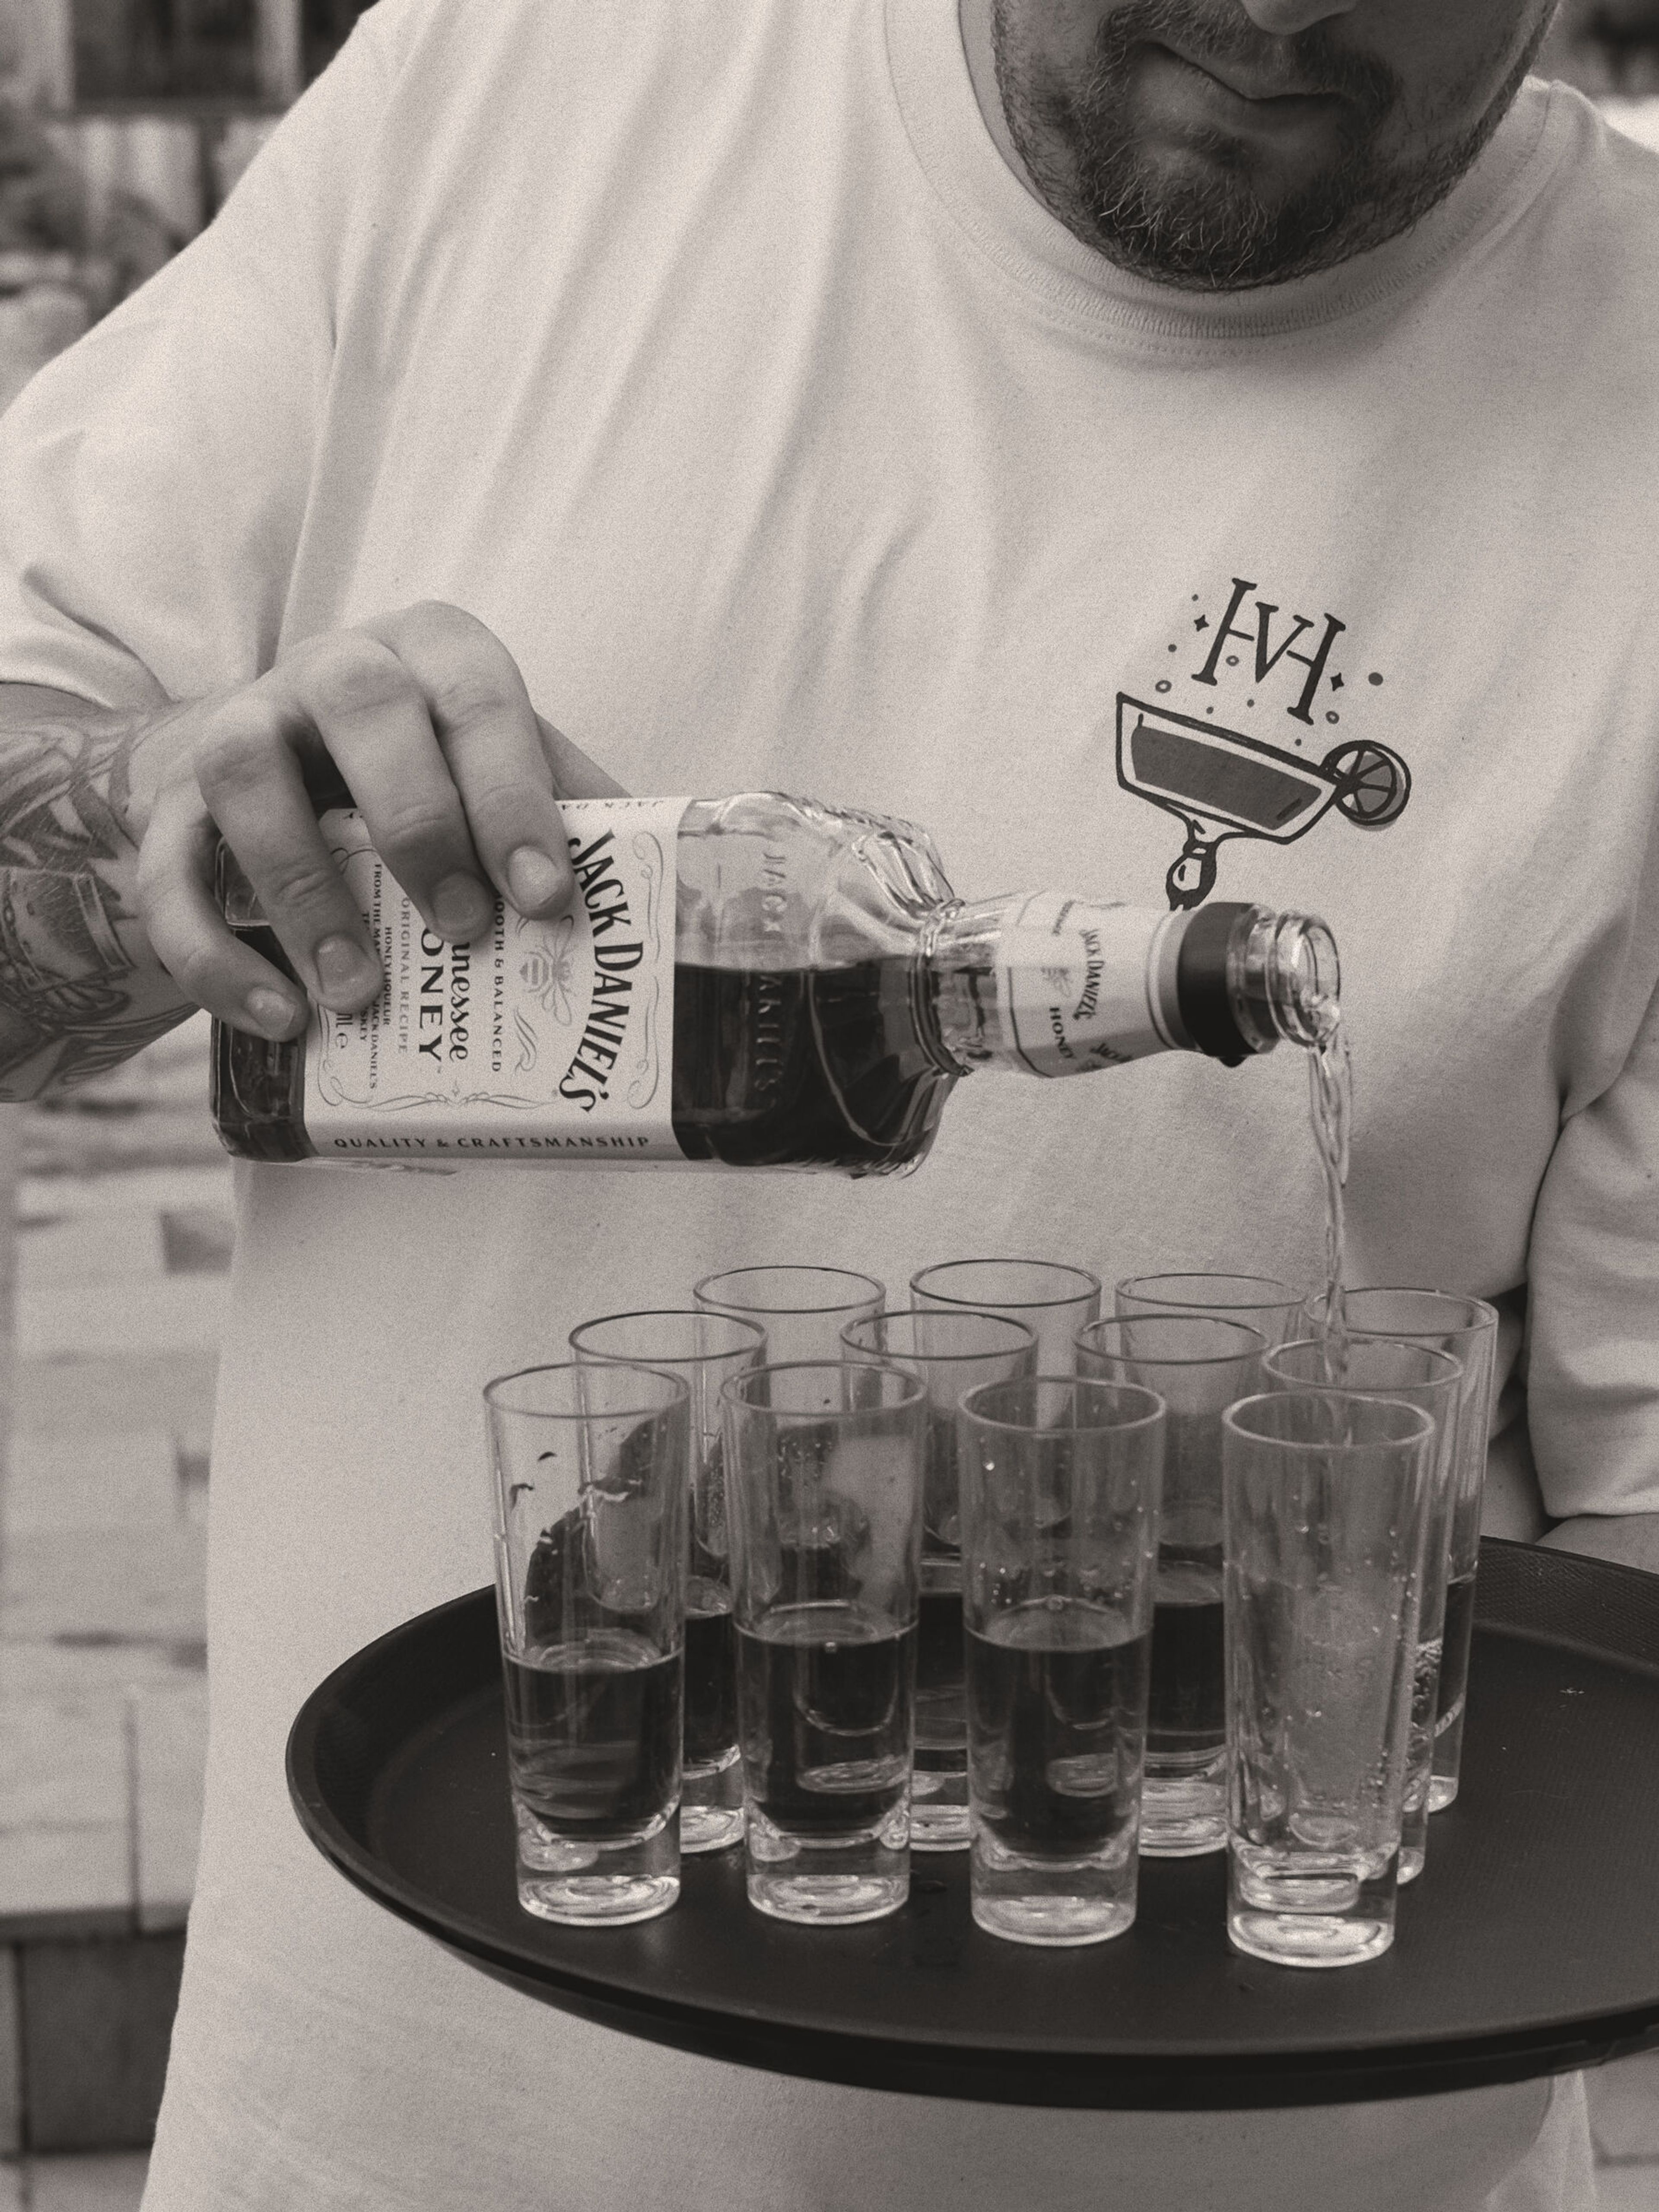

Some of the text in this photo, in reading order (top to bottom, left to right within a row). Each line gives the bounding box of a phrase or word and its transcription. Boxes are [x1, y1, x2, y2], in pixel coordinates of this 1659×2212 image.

[373, 864, 382, 899] FROM
[383, 928, 392, 1025] HONEY LIQUEUR
[399, 898, 410, 1053] ORIGINAL RECIPE
[419, 928, 444, 1062] ONEY
[449, 942, 470, 1062] nessee
[492, 893, 505, 1071] OOTH & BALANCED
[559, 828, 643, 1112] JACK DANIEL'S
[1072, 929, 1105, 1021] JACK DANIEL'S
[369, 1034, 378, 1089] DANIEL'S
[1049, 1007, 1076, 1058] HONEY
[334, 1136, 649, 1149] QUALITY & CRAFTSMANSHIP
